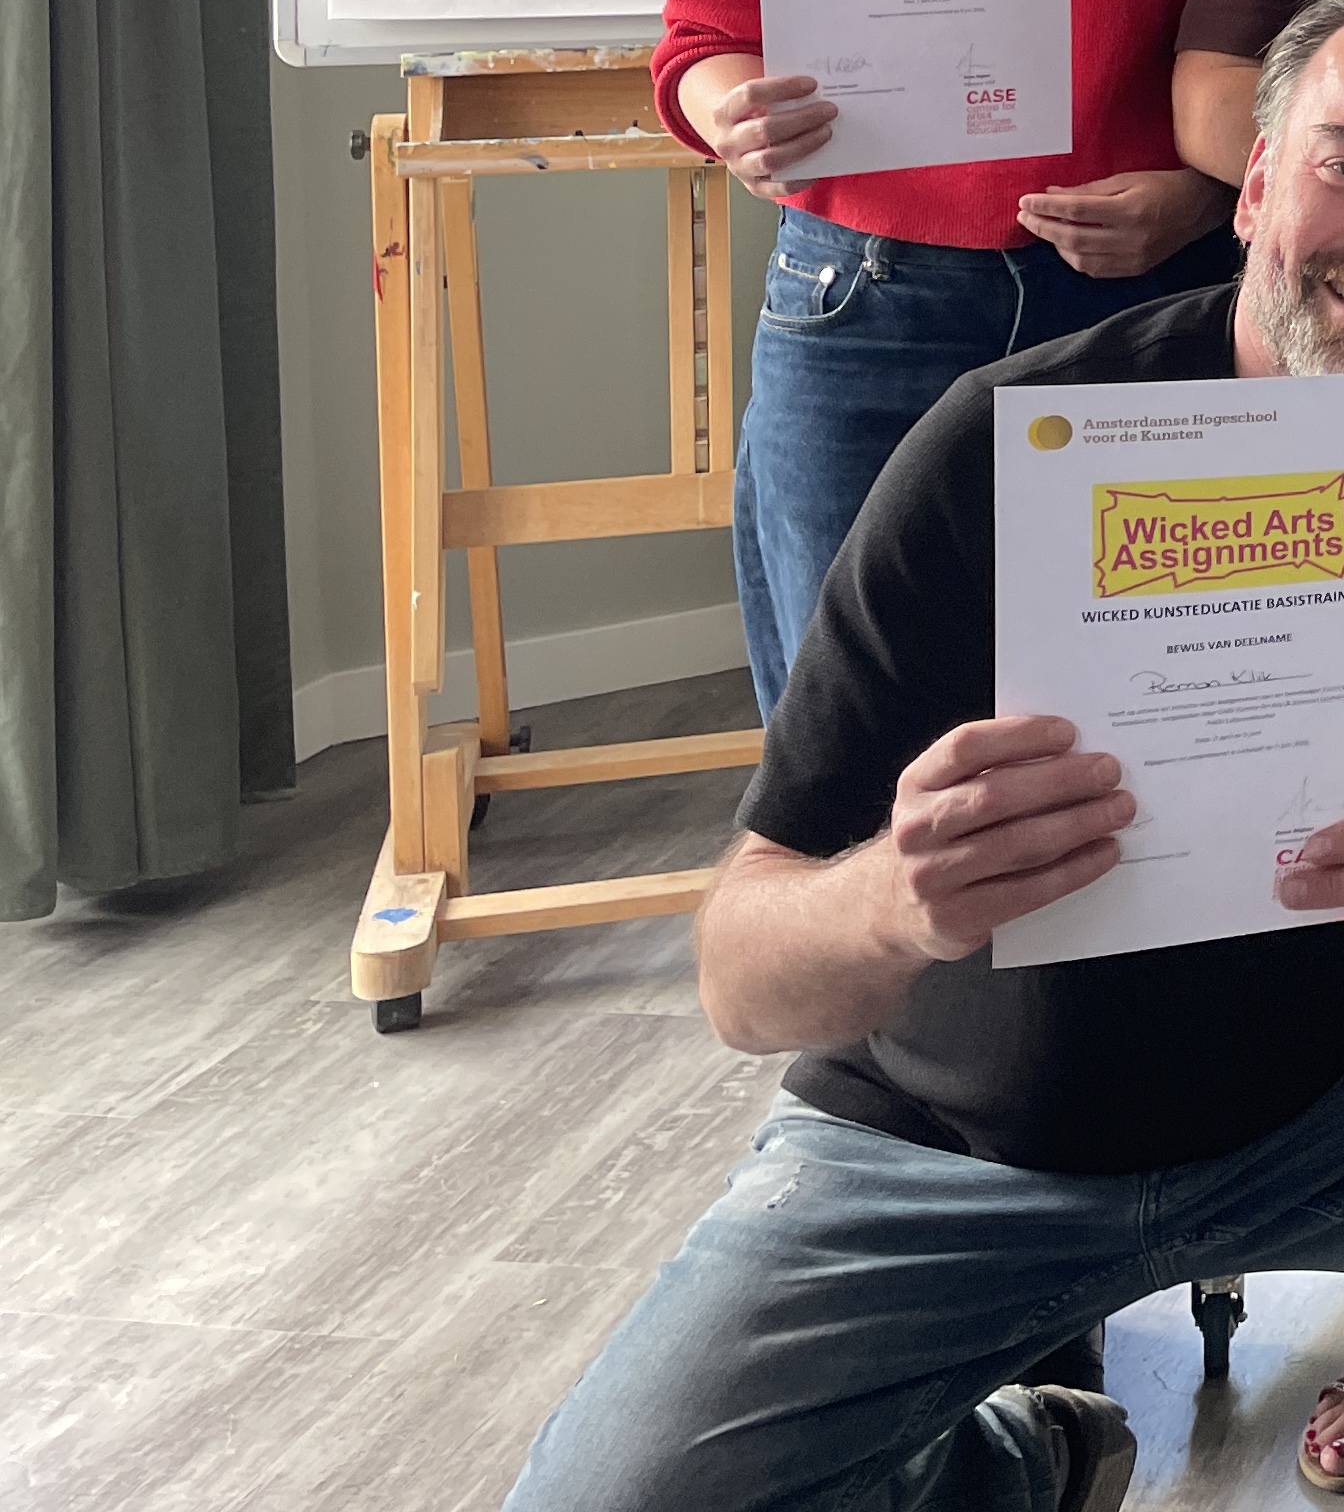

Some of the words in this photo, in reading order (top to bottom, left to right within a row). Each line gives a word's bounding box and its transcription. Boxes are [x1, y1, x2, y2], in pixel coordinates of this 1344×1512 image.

[967, 88, 1017, 104] CASE
[1083, 414, 1189, 431] Amsterdamse
[1192, 411, 1277, 428] Hogeschool
[1083, 434, 1116, 444] voor
[1119, 431, 1138, 443] de
[1140, 429, 1204, 442] Kunsten
[1123, 512, 1253, 545] Wicked
[1263, 508, 1335, 537] Arts
[1111, 532, 1343, 574] Assignments
[1082, 608, 1139, 624] WICKED
[1143, 598, 1262, 620] KUNSTEDUCATIE
[1208, 640, 1231, 650] VAN
